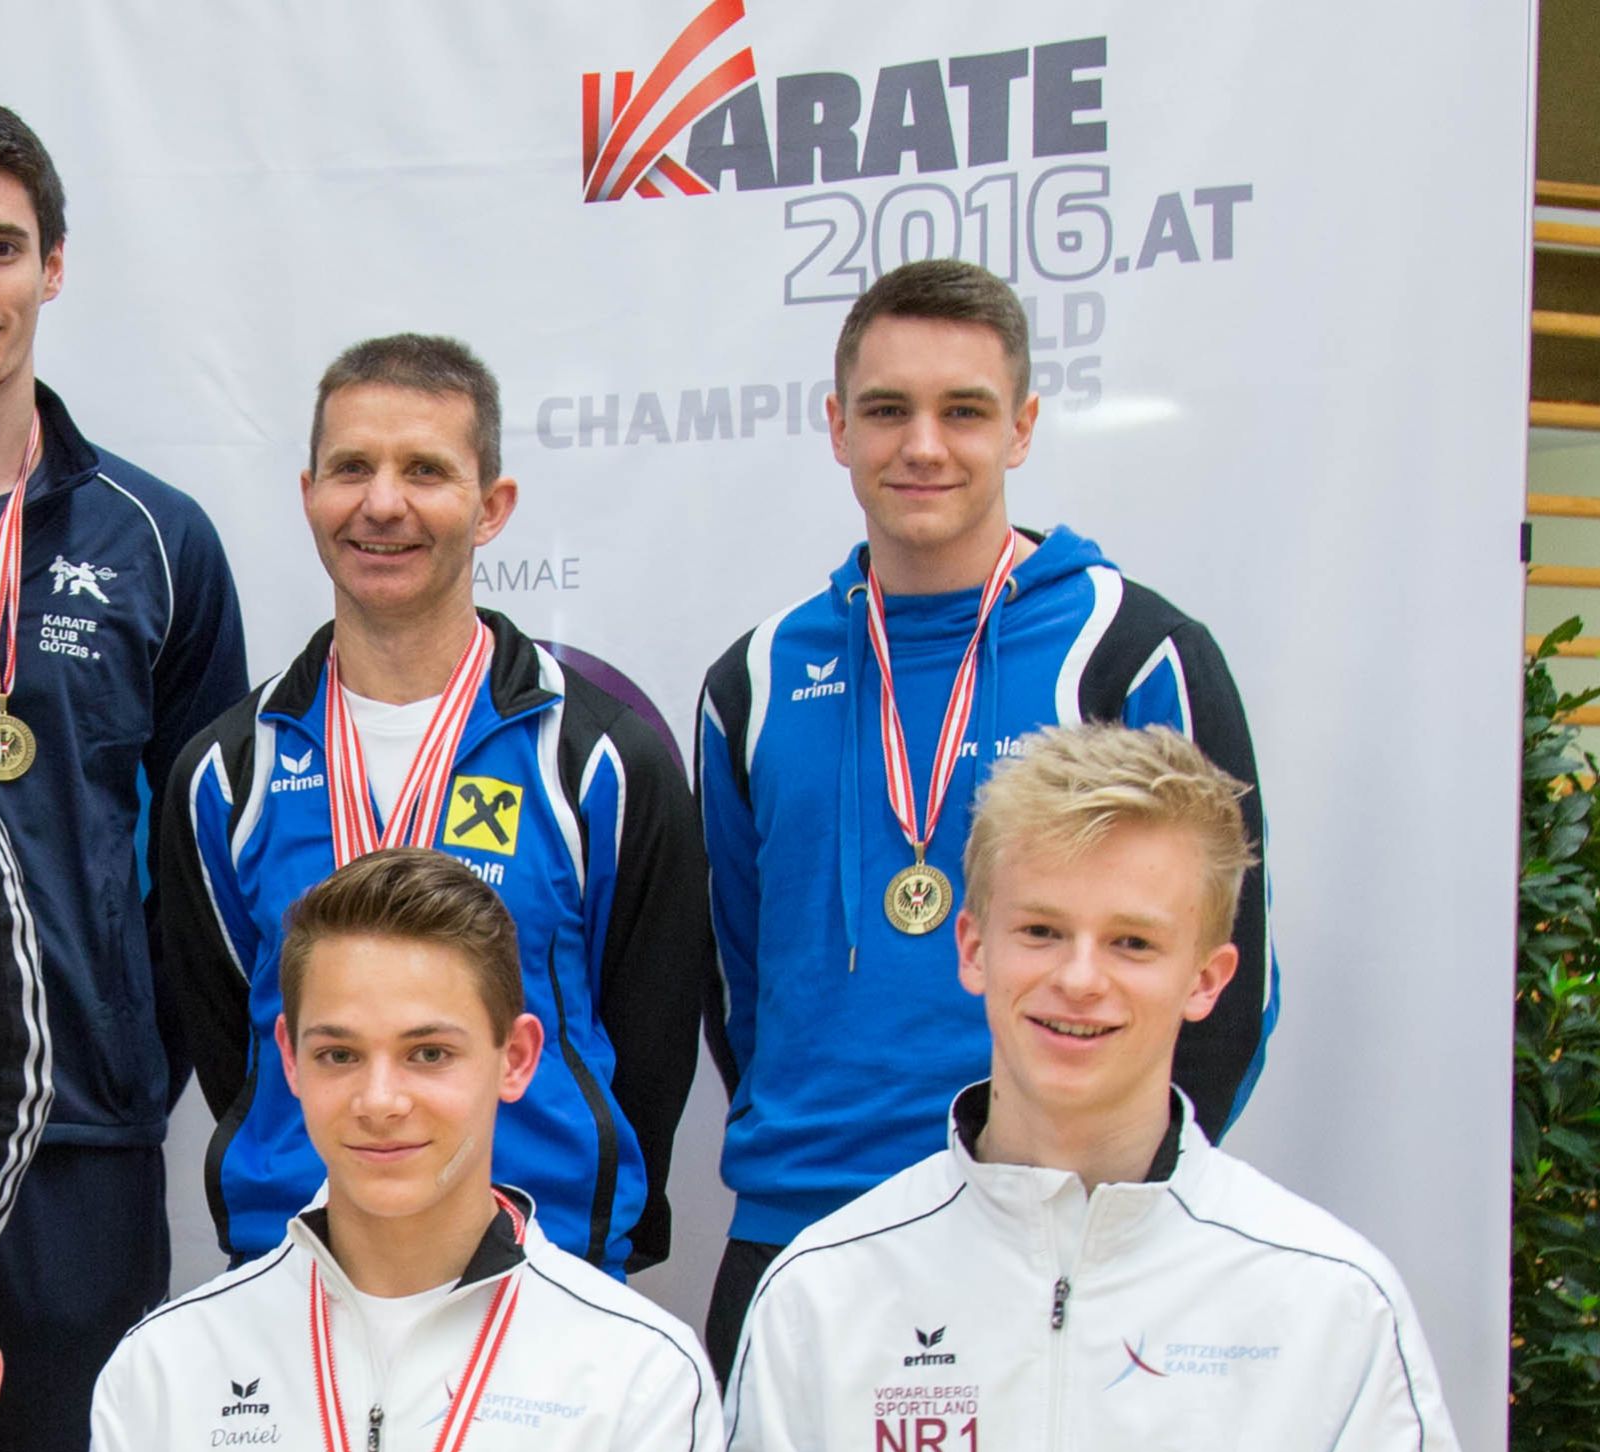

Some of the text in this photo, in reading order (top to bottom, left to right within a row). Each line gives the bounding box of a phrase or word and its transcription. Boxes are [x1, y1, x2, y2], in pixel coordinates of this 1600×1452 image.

[582, 0, 1107, 203] KARATE
[473, 558, 580, 592] AMAE
[42, 614, 97, 632] KARATE
[41, 627, 78, 642] CLUB
[39, 637, 89, 658] GÖTZIS
[791, 680, 845, 701] erima
[270, 772, 324, 794] erima
[903, 1352, 956, 1367] erima
[221, 1402, 270, 1417] erima
[480, 1407, 541, 1428] KARATE
[874, 1400, 978, 1417] SPORTLAND
[210, 1424, 281, 1447] Daniel
